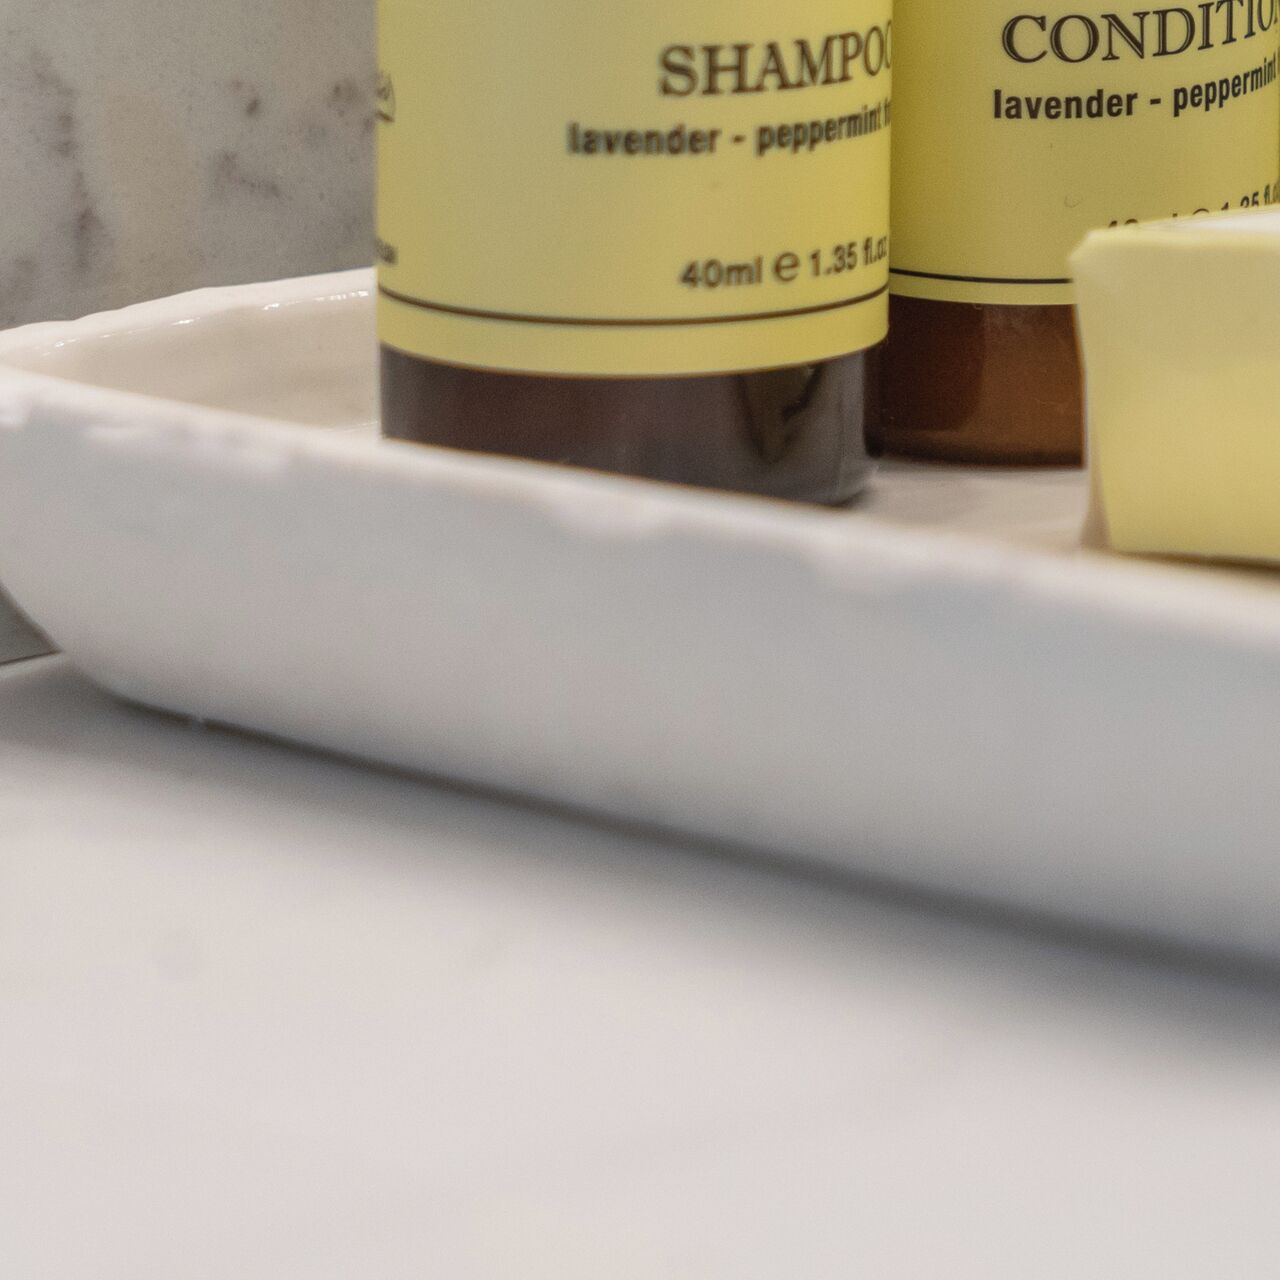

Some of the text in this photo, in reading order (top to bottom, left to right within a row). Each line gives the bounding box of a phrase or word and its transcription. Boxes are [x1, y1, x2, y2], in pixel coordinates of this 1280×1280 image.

[993, 88, 1138, 120] lavender
[1173, 51, 1276, 117] peppermint
[566, 122, 720, 155] lavender
[756, 101, 881, 158] peppermint
[681, 254, 763, 288] 40ml
[810, 241, 858, 277] 1.35
